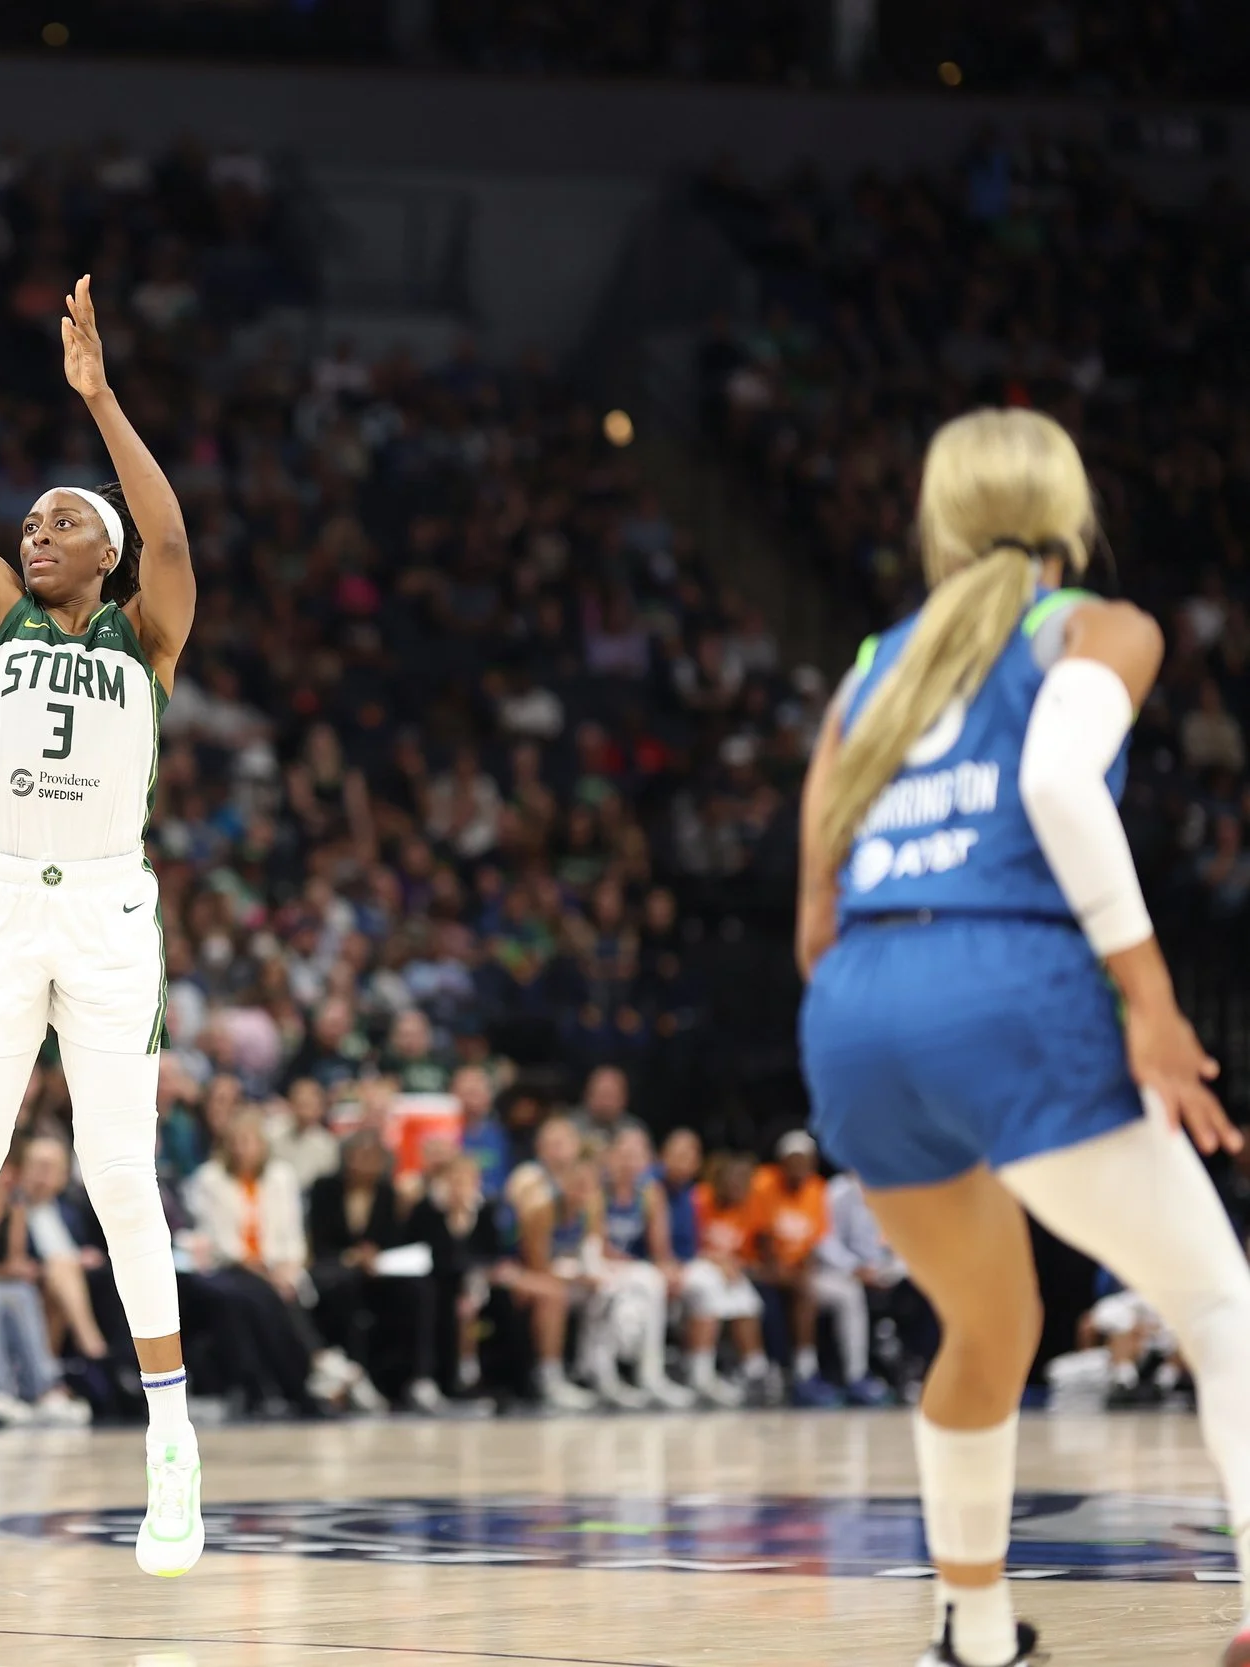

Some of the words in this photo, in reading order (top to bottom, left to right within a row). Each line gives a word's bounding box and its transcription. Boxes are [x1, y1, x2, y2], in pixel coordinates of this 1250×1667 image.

[1, 650, 125, 709] STORM
[42, 702, 74, 760] 3
[38, 788, 83, 801] SWEDISH
[39, 771, 100, 787] Providence
